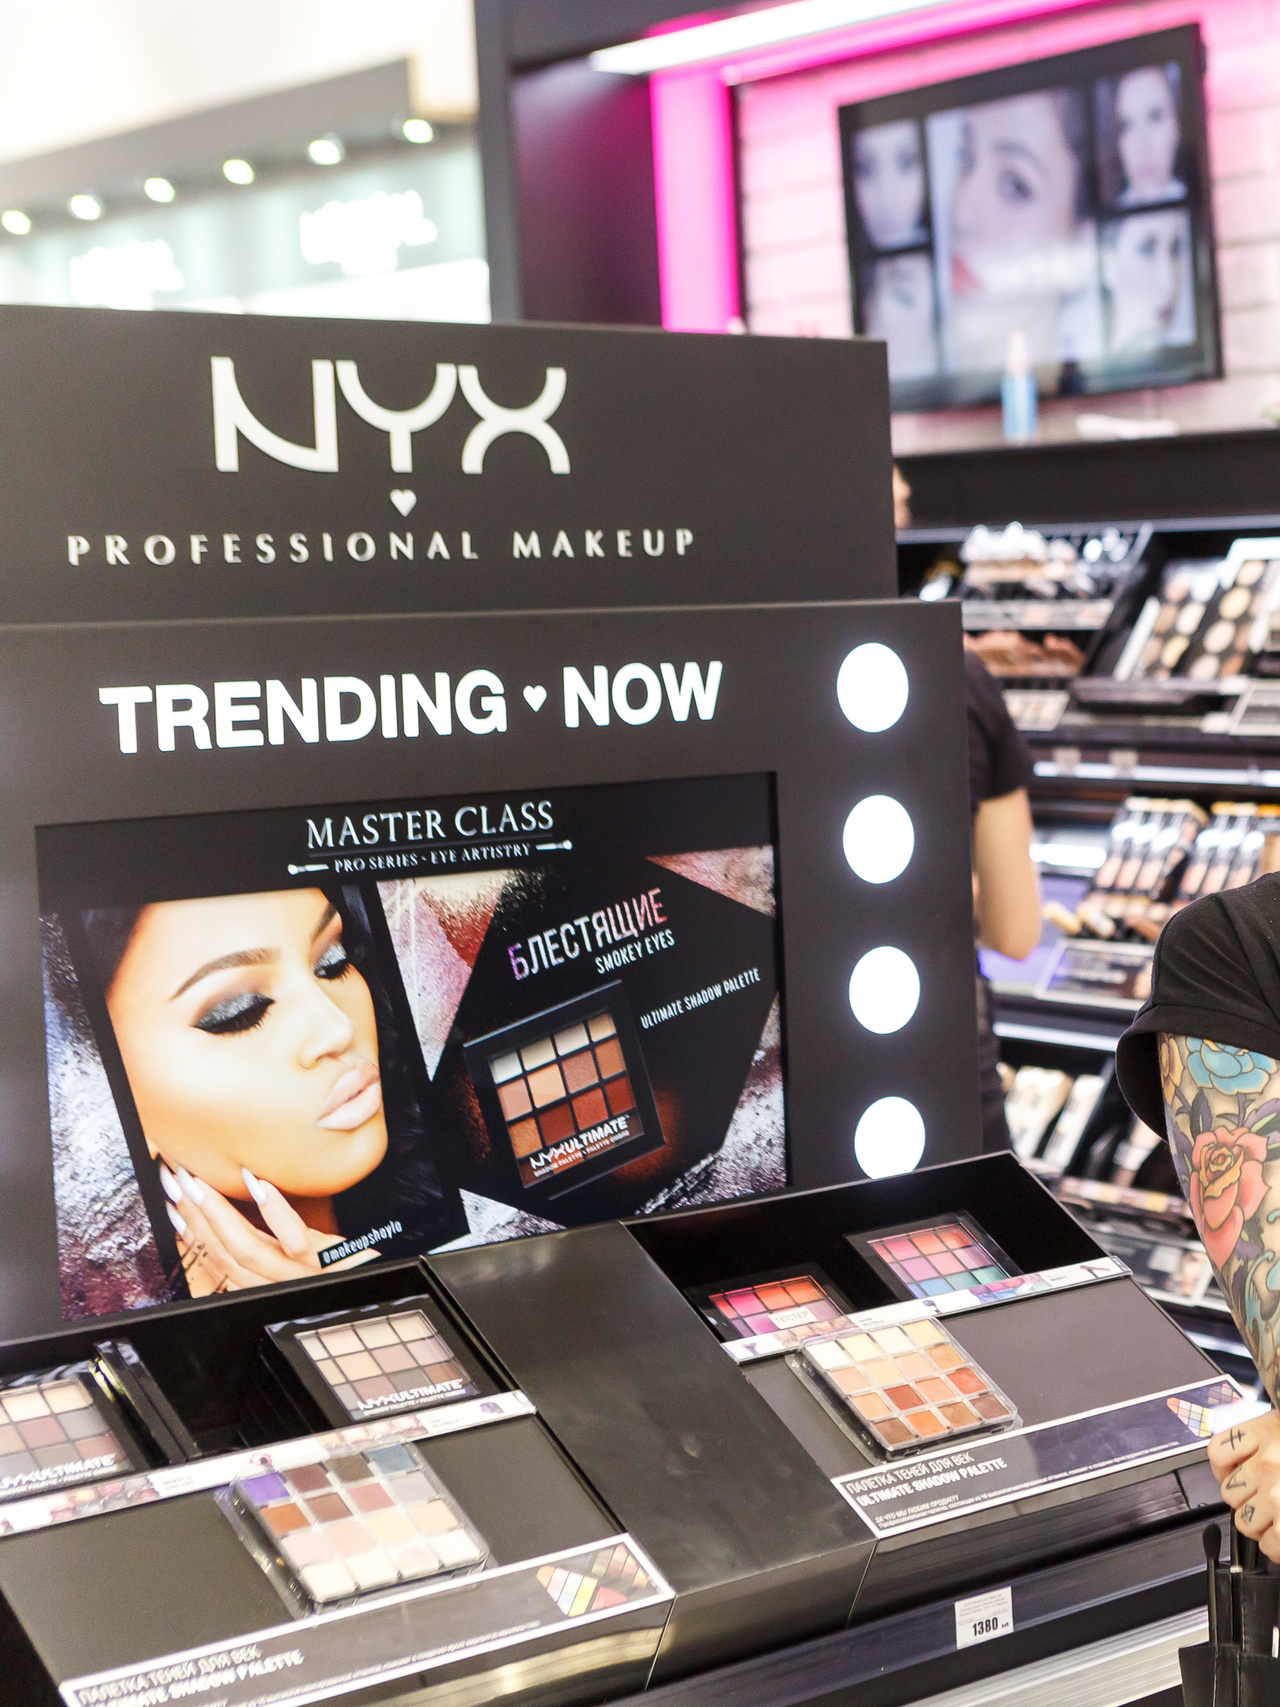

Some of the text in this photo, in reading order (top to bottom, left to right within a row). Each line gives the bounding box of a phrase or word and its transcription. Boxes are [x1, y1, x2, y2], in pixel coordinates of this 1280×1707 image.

[211, 356, 571, 475] NYX
[66, 528, 696, 566] PROFESSIONAL MAKEUP
[98, 660, 724, 755] TRENDING NOW
[306, 800, 554, 849] MASTER CLASS
[334, 842, 531, 873] PRO SERIES EYE ARTISTRY
[507, 887, 668, 981] БЛЕСТЯЩИЕ
[594, 928, 676, 975] SMOKEY EYES
[640, 967, 762, 1030] ULTIMATE SHADOW PALETTE
[529, 1144, 566, 1170] NYX
[775, 1310, 810, 1325] ТЕСТЕР
[397, 1378, 463, 1403] ULTIMATE
[36, 1452, 116, 1480] ULTIMATE
[846, 1451, 975, 1494] ПАЛЕТКА ТЕНЕЙ ДЛЯ ВЕК
[855, 1457, 1008, 1507] ULTIMATE SHADOW PALETTE
[972, 1617, 998, 1637] 1380
